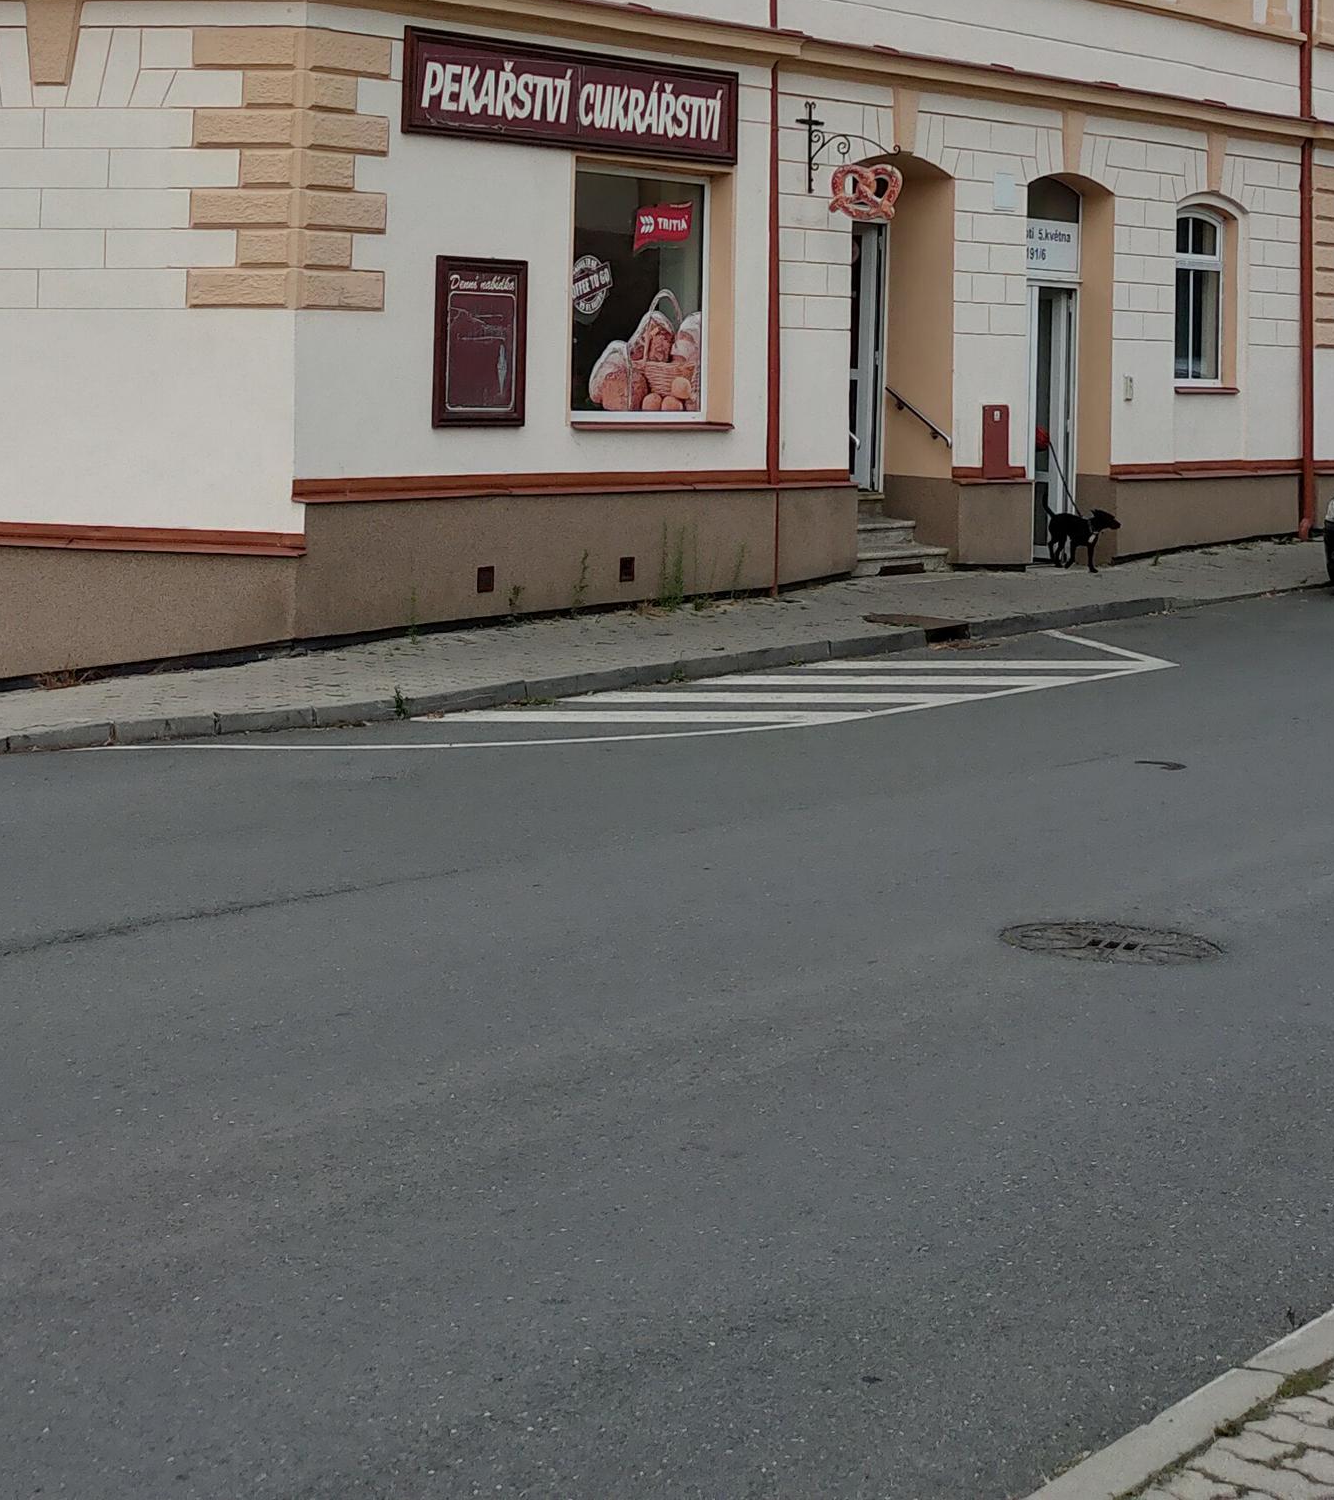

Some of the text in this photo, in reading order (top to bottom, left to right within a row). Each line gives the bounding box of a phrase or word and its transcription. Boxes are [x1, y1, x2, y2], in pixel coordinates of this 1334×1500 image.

[420, 60, 724, 142] PEKAŘSTVÍ CUKRÁŘSTVÍ
[657, 216, 688, 231] TRITIA
